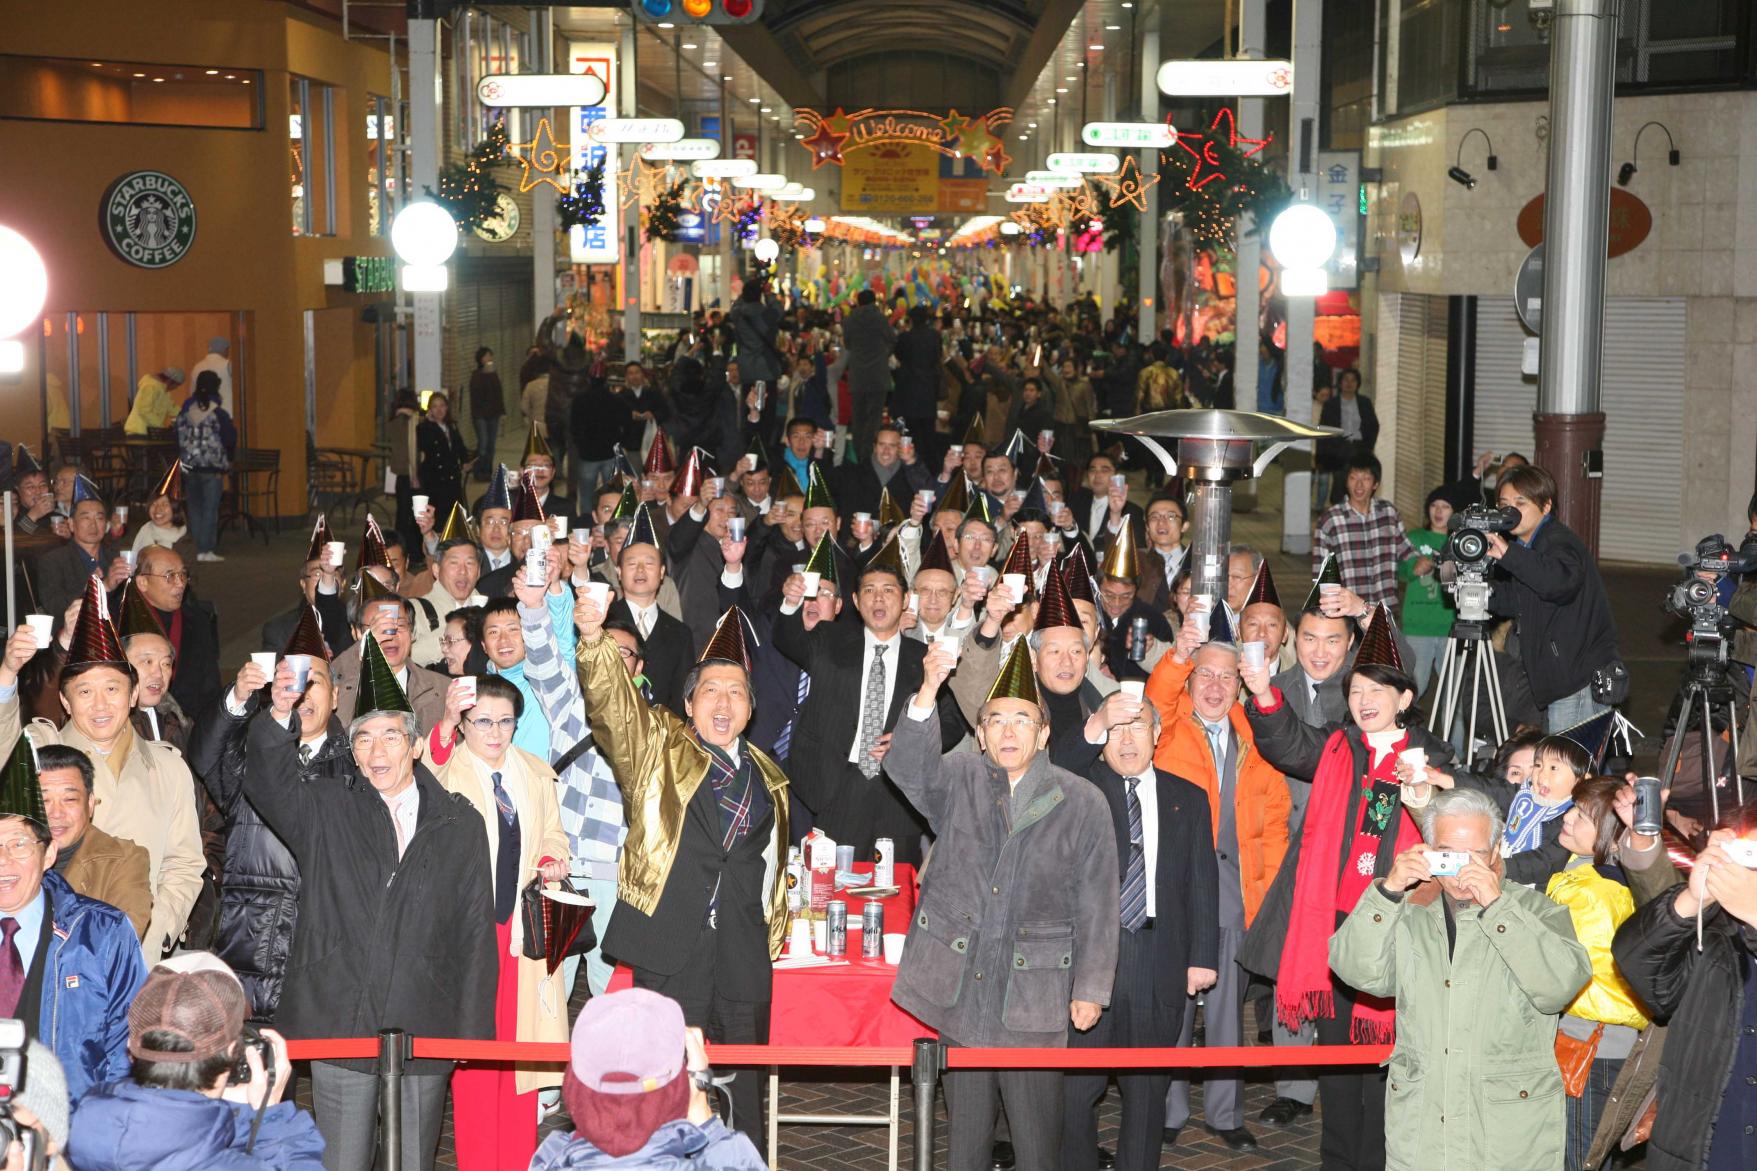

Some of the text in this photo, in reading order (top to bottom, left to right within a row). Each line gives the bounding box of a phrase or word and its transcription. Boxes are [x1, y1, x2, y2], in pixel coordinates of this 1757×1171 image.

[852, 116, 943, 144] Welcome
[579, 105, 607, 250] 西沢店
[111, 175, 191, 219] STARBUCKS
[121, 238, 184, 263] COFFEE
